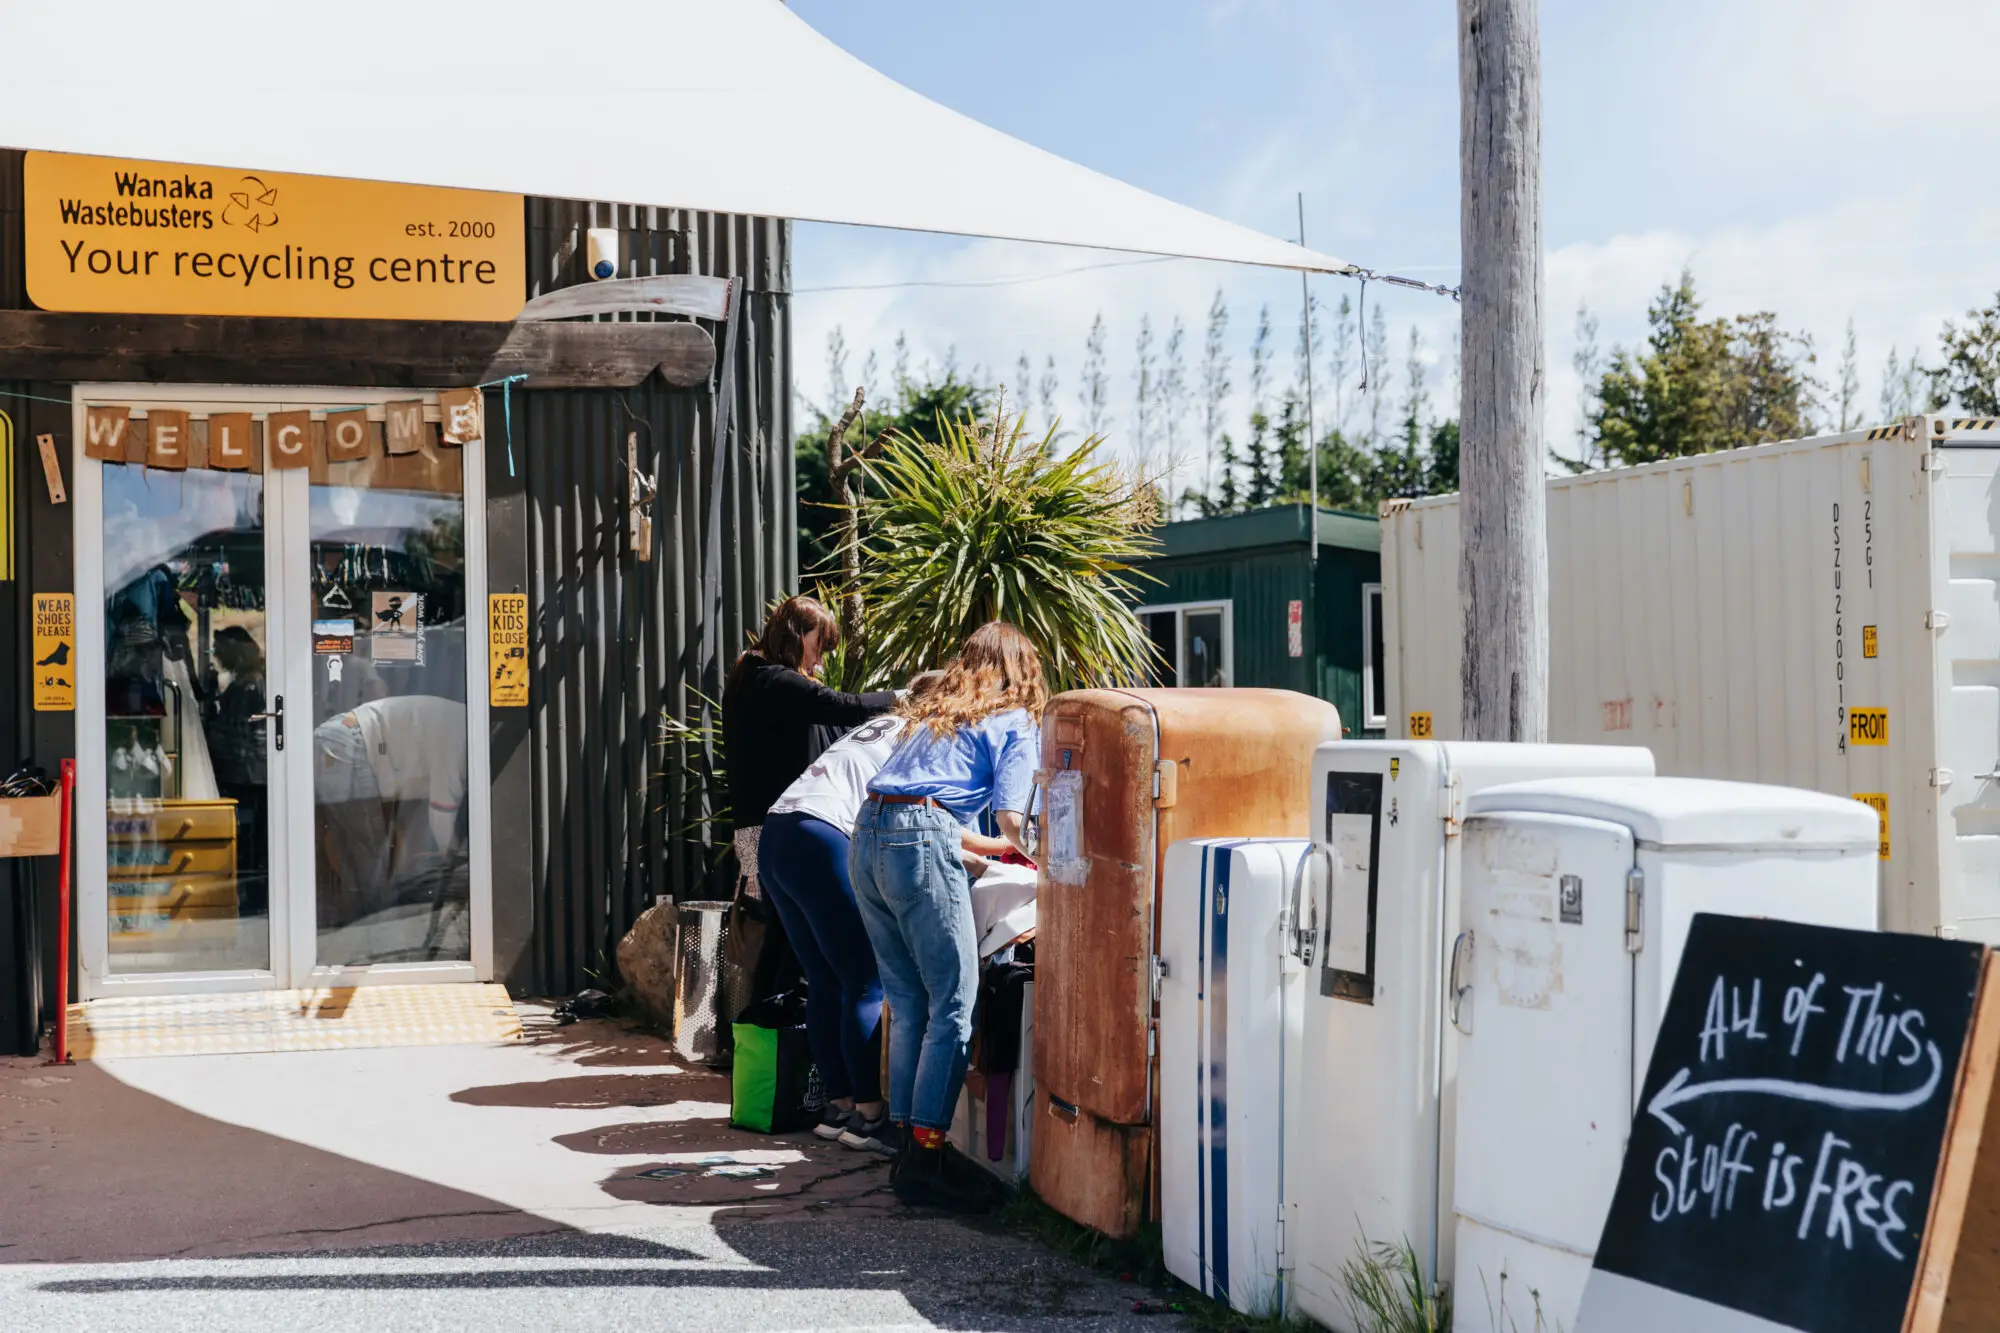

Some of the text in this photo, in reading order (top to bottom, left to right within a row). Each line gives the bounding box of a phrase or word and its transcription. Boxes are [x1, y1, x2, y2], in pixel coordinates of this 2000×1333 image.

[114, 171, 213, 200] Wanaka
[59, 198, 214, 230] Wastebusters
[405, 220, 495, 239] est. 2000
[60, 239, 496, 290] Your recycling centre
[87, 403, 470, 456] WELCOME
[1864, 500, 1873, 589] 25G1
[37, 599, 71, 612] WEAR
[493, 599, 524, 614] KEEP
[37, 613, 71, 625] SHOES
[493, 615, 524, 630] KIDS
[37, 626, 71, 637] PLEASE
[493, 632, 524, 644] CLOSE
[1783, 971, 1825, 1057] of
[1762, 1141, 1804, 1212] is
[1797, 1131, 1915, 1261] FREE
